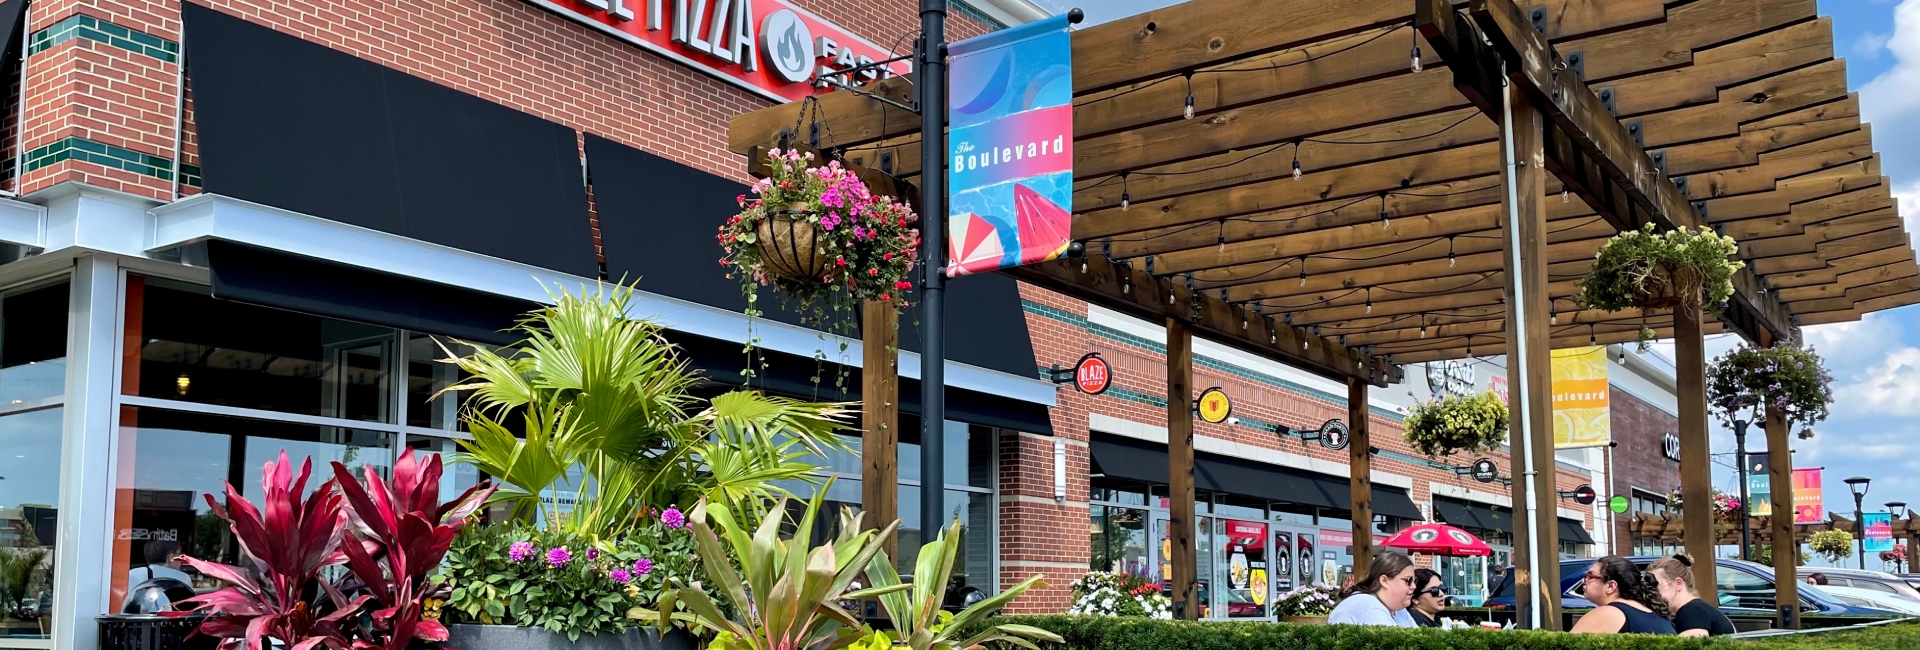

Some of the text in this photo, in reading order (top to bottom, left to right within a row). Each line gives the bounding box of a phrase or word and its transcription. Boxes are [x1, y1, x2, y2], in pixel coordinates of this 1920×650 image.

[646, 0, 758, 73] IZZA
[954, 141, 976, 155] The
[954, 134, 1063, 174] Boulevard
[1080, 364, 1104, 382] BLAZE
[1552, 390, 1605, 402] oulevard
[1665, 432, 1681, 461] COR
